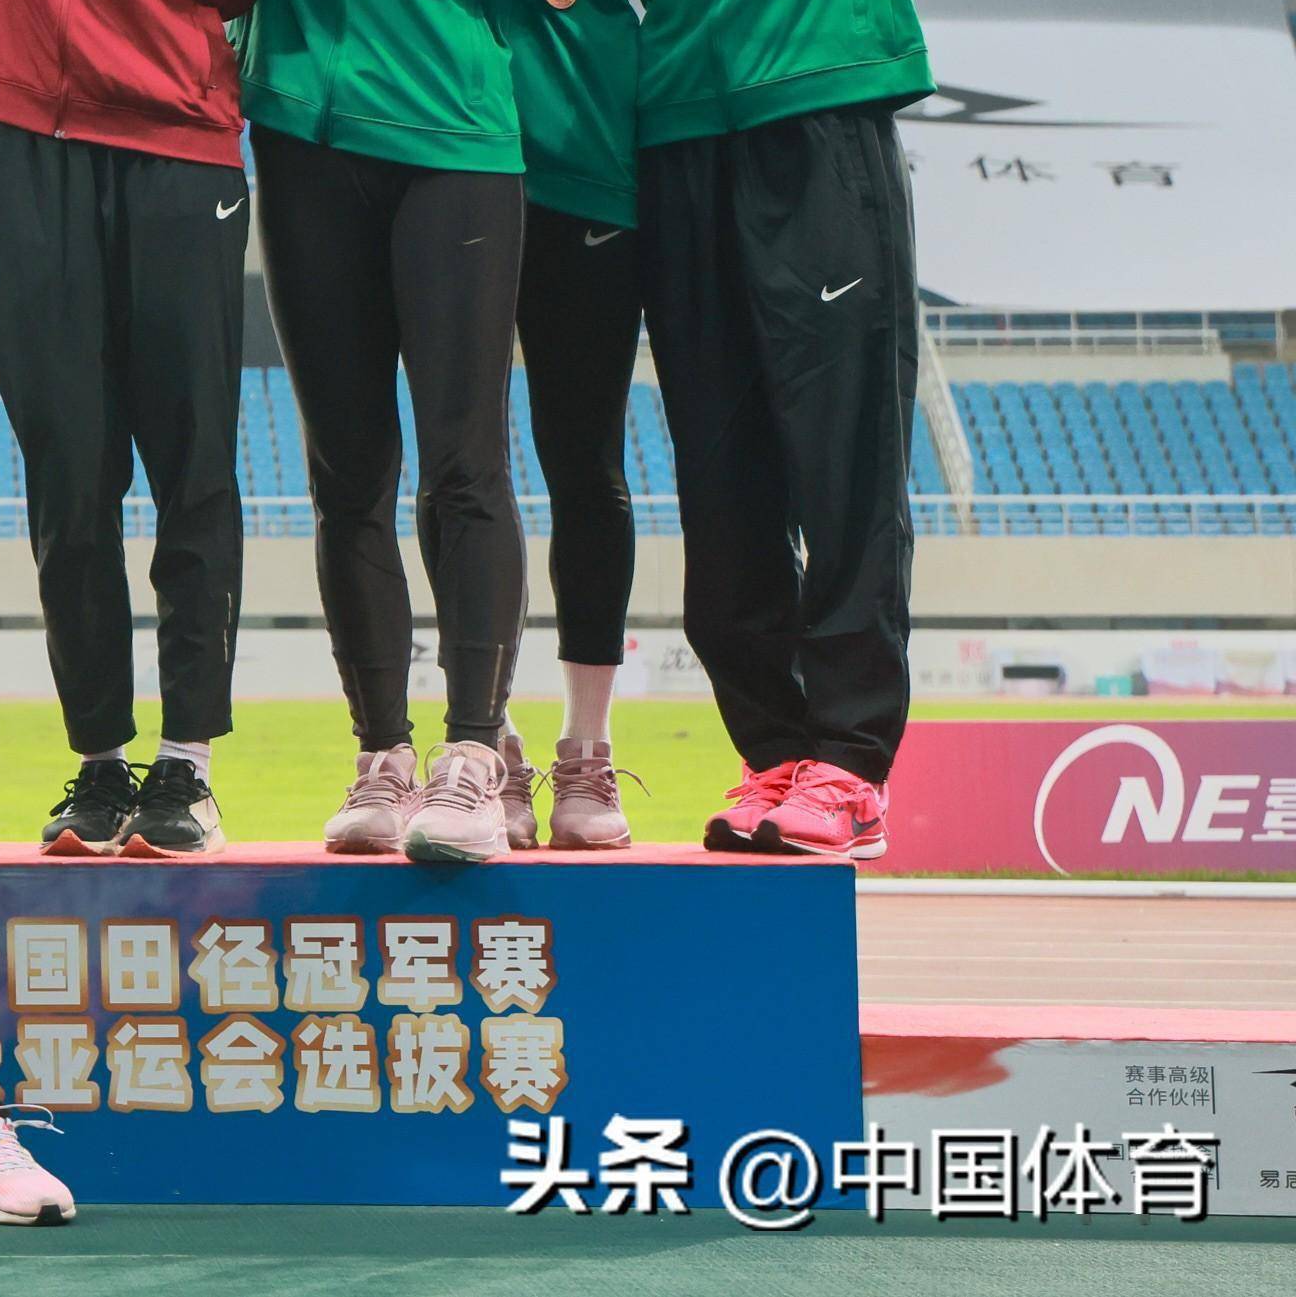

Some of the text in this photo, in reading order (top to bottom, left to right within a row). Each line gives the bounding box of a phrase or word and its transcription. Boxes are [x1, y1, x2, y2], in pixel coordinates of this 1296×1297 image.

[1124, 1064, 1210, 1085] 赛事高级
[1125, 1087, 1211, 1107] 合作伙伴
